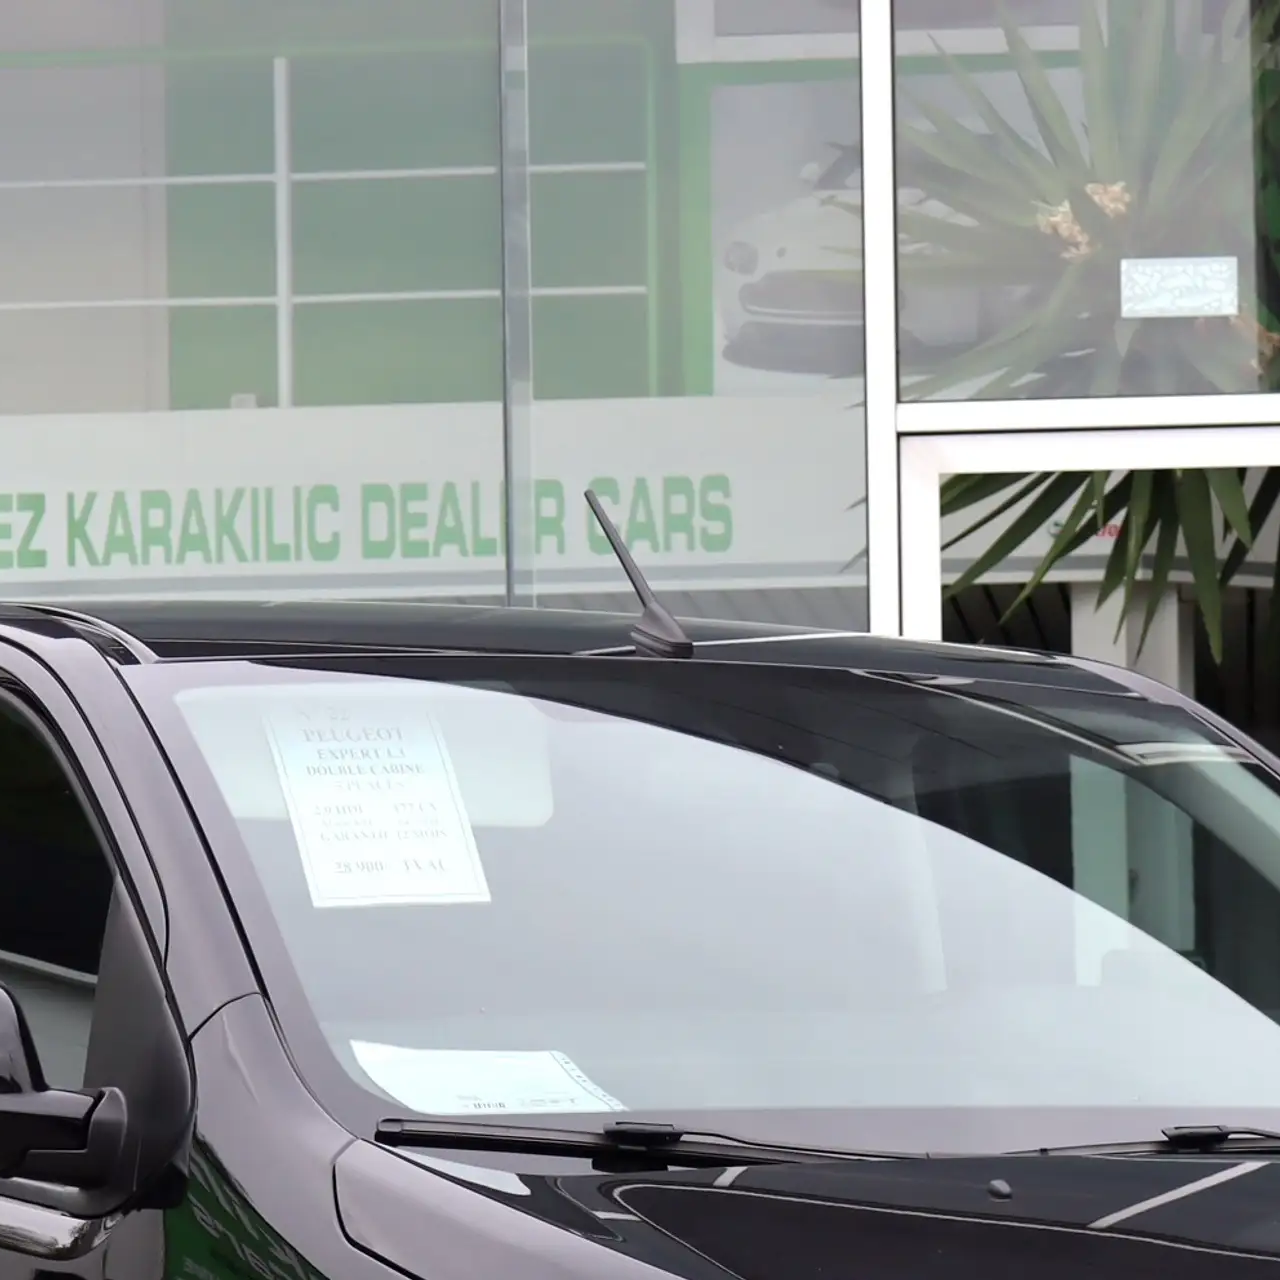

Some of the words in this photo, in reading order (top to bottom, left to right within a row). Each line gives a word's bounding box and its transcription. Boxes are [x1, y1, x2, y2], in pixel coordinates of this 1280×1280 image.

[67, 485, 341, 567] KARAKILIC
[363, 482, 565, 560] DEALR
[586, 476, 733, 555] CARS
